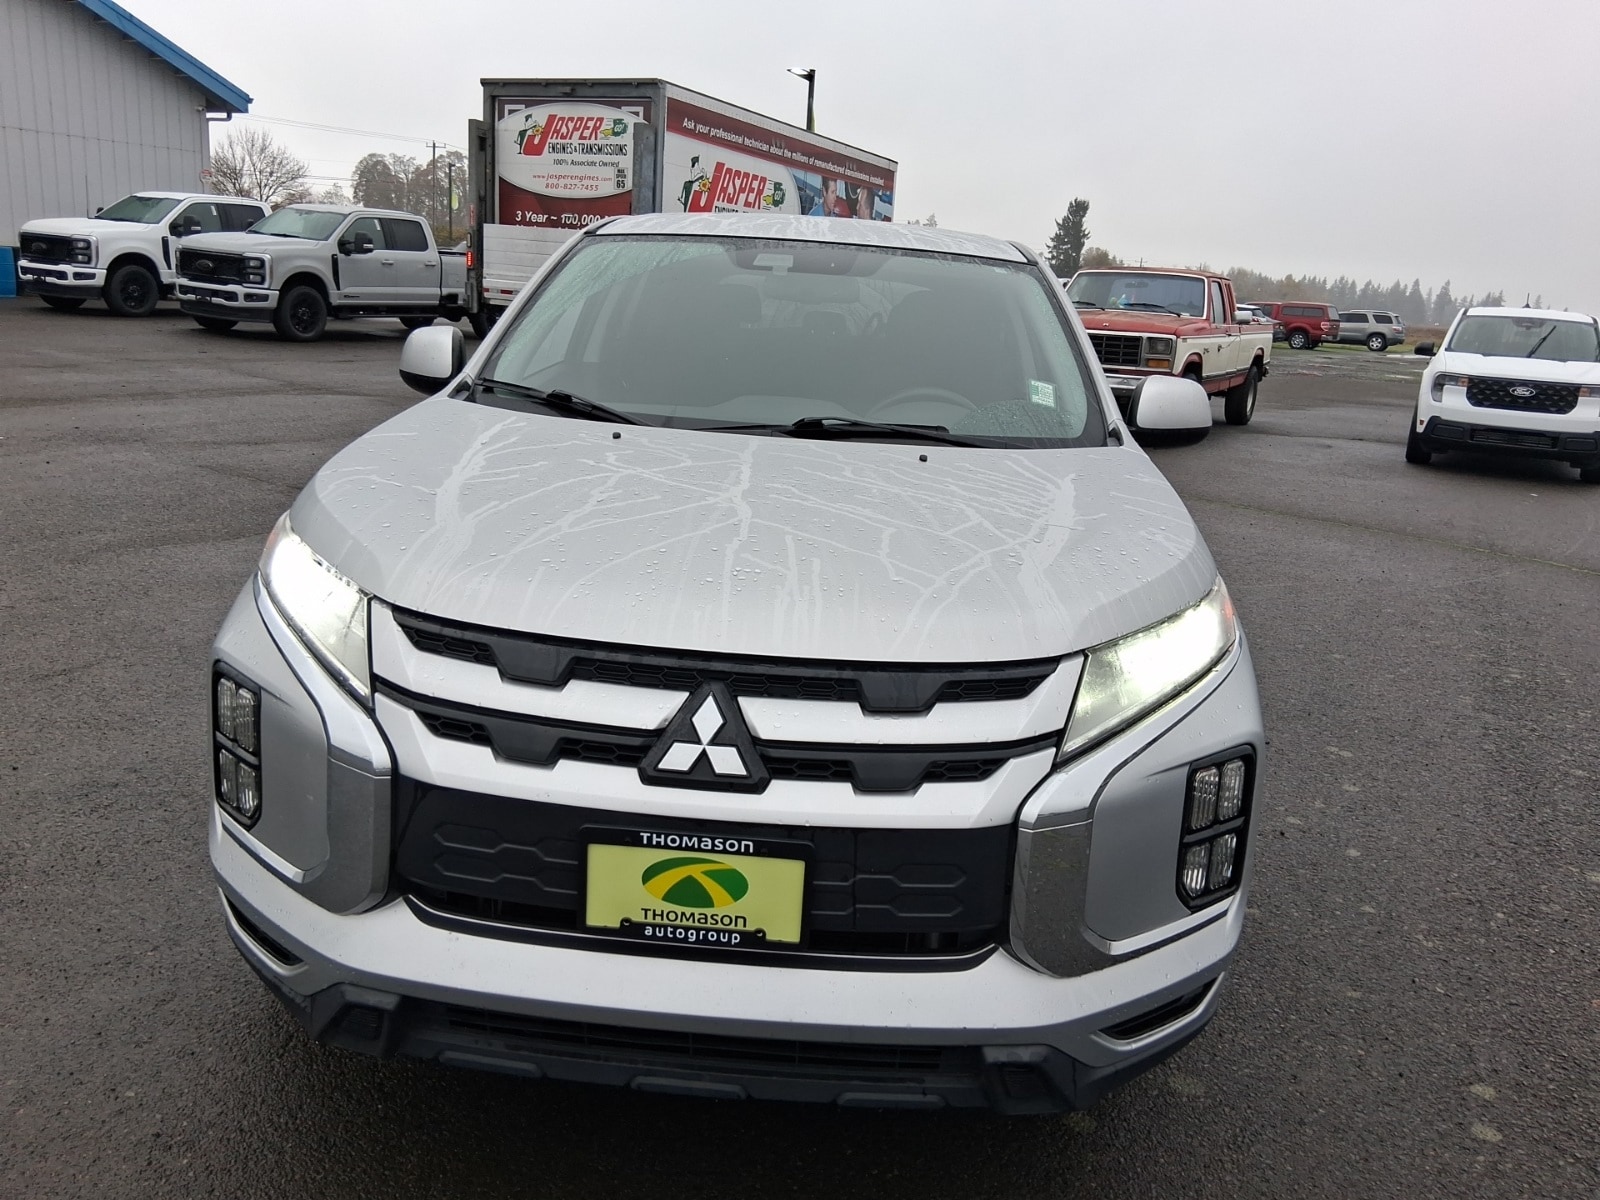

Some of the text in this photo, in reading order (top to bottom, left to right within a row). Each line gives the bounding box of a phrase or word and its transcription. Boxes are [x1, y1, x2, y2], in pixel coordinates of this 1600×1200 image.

[522, 114, 605, 156] JASPER
[682, 117, 695, 130] Ask
[696, 123, 710, 134] your
[710, 127, 744, 144] professional
[744, 136, 769, 152] technician
[770, 144, 783, 157] about
[783, 148, 791, 159] the
[792, 151, 808, 164] millions
[809, 155, 815, 166] of
[548, 142, 574, 155] ENGINES
[578, 143, 628, 156] TRANSMISSIONS
[598, 160, 620, 168] Owned
[532, 173, 613, 183] www.jasperengines.com
[616, 180, 626, 189] 65
[545, 182, 599, 192] 800-827-7455
[688, 161, 767, 212] JASPER
[515, 211, 522, 221] 3
[525, 211, 549, 223] Year
[644, 925, 741, 945] autogroup
